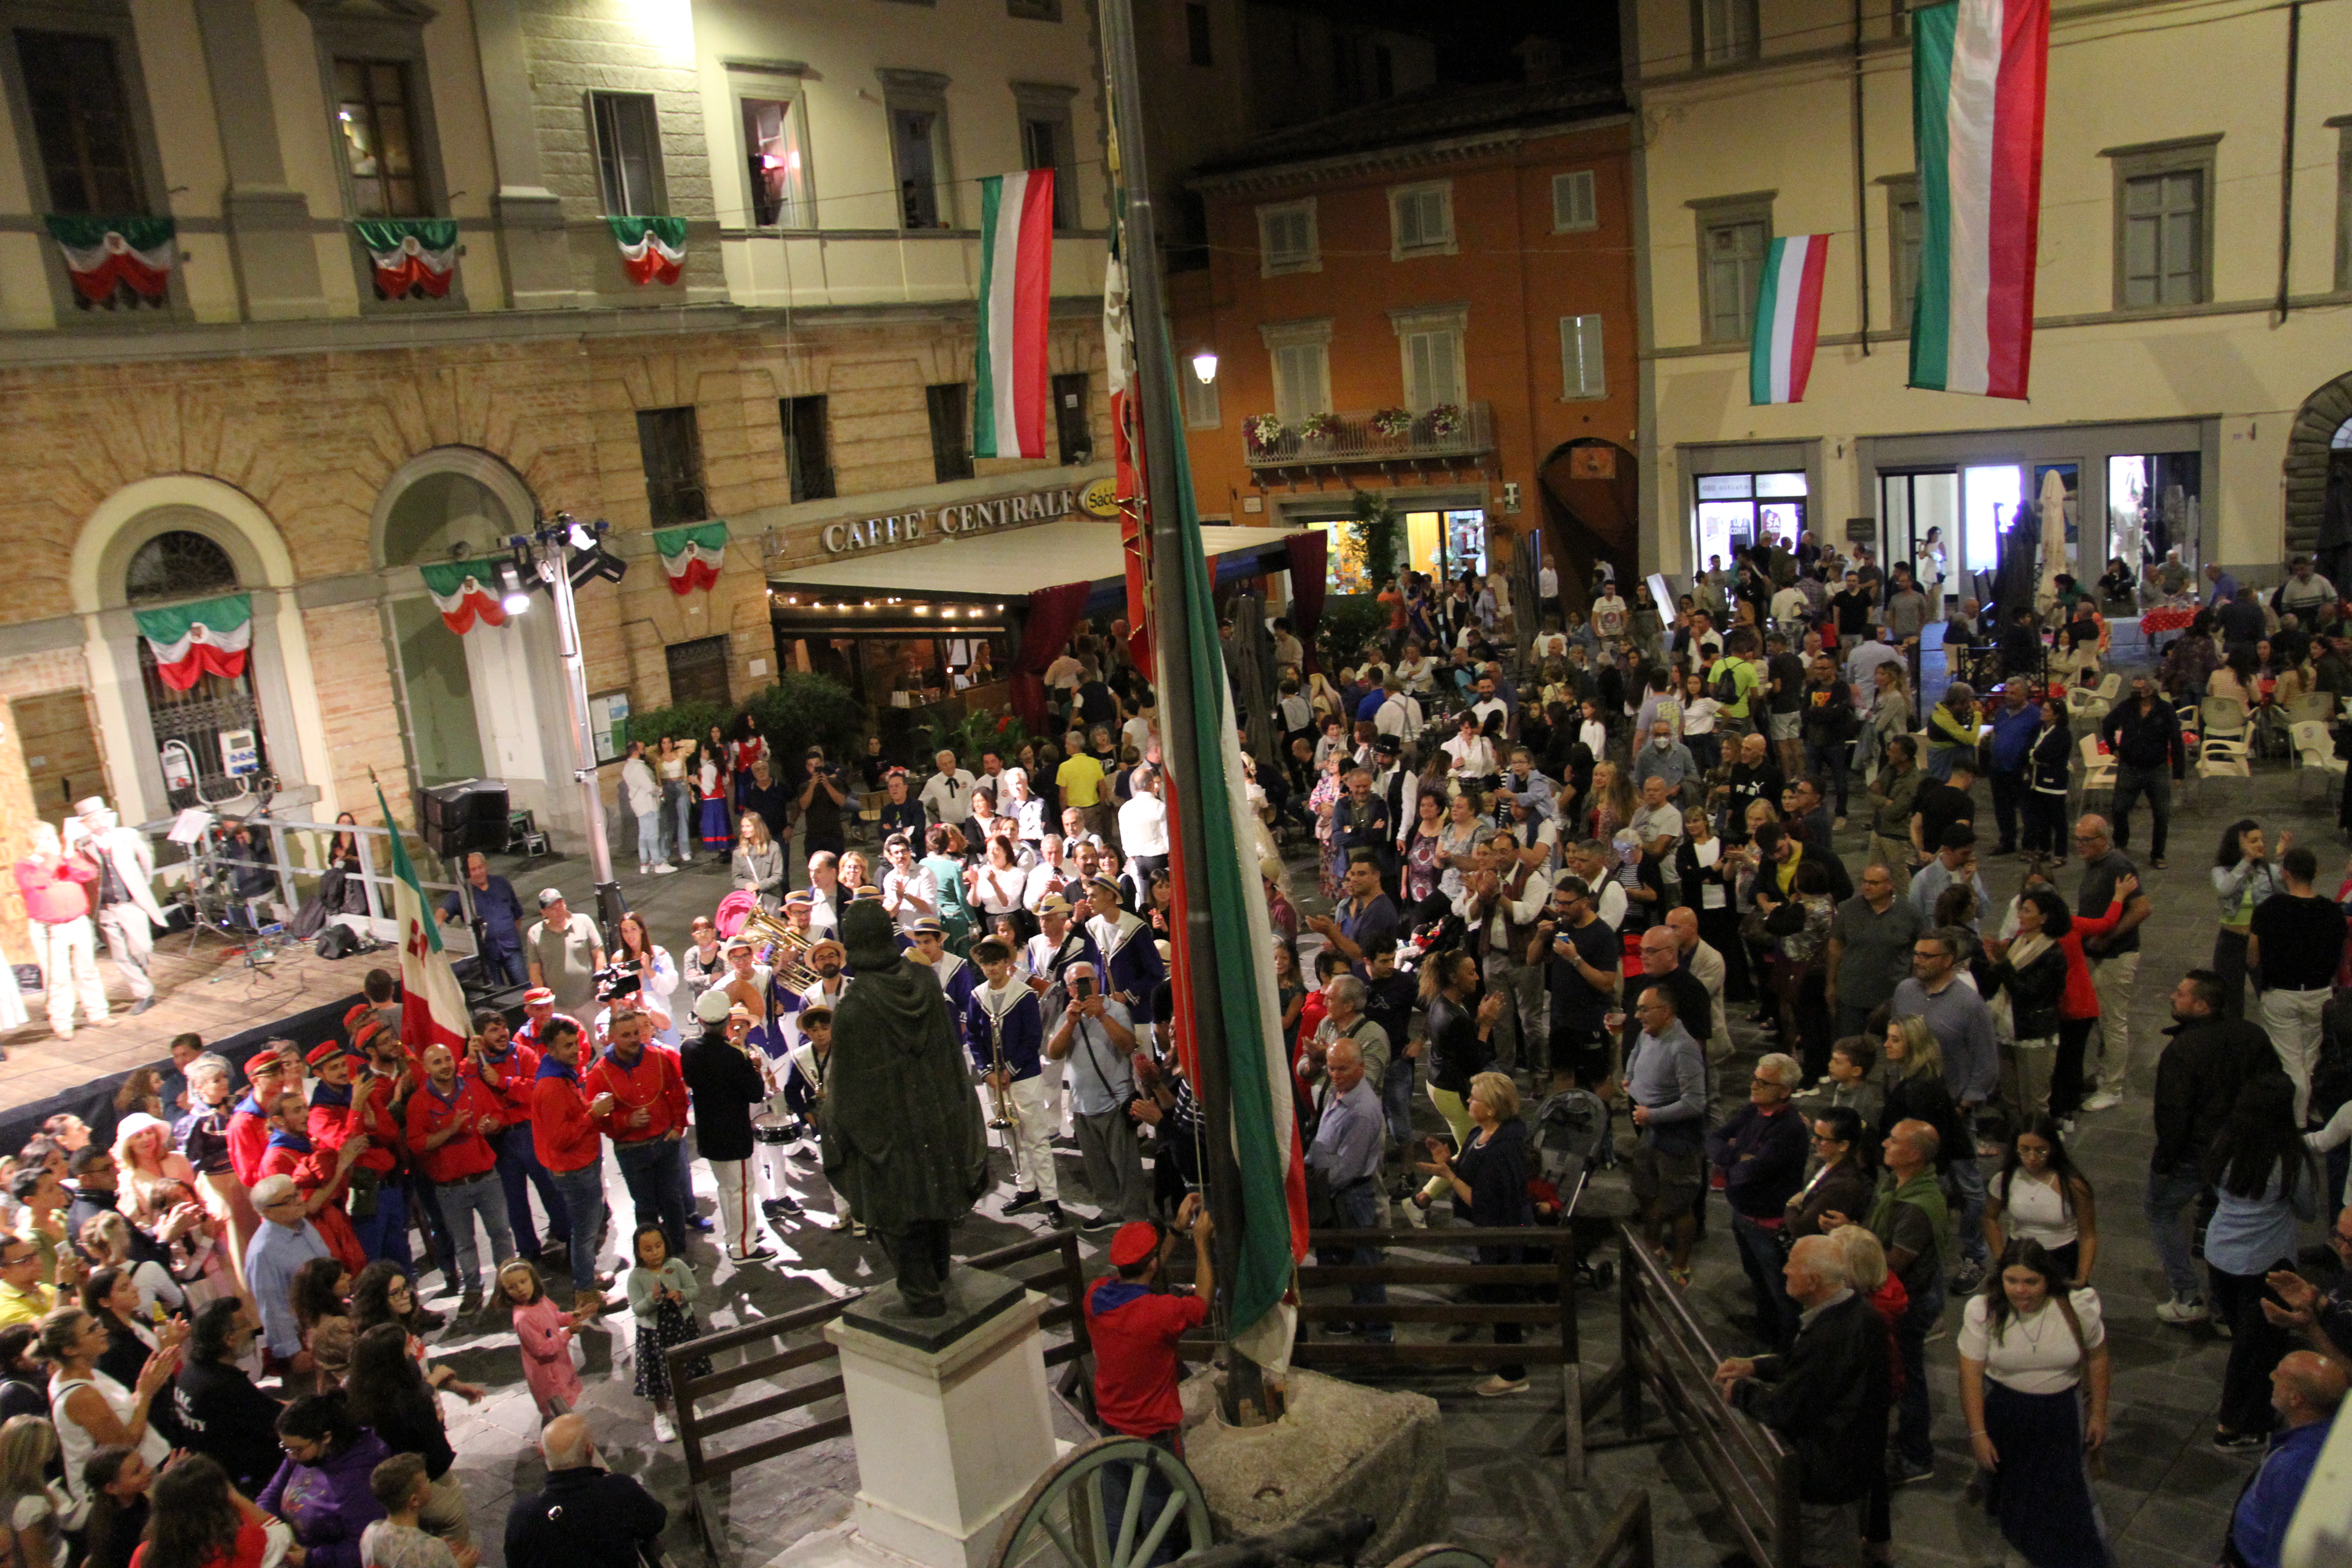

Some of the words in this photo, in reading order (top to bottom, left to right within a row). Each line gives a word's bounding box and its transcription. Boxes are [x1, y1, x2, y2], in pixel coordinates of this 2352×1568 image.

[1089, 492, 1115, 508] Sacc
[822, 509, 926, 553] CAFFE'
[937, 489, 1073, 534] CENTRALE
